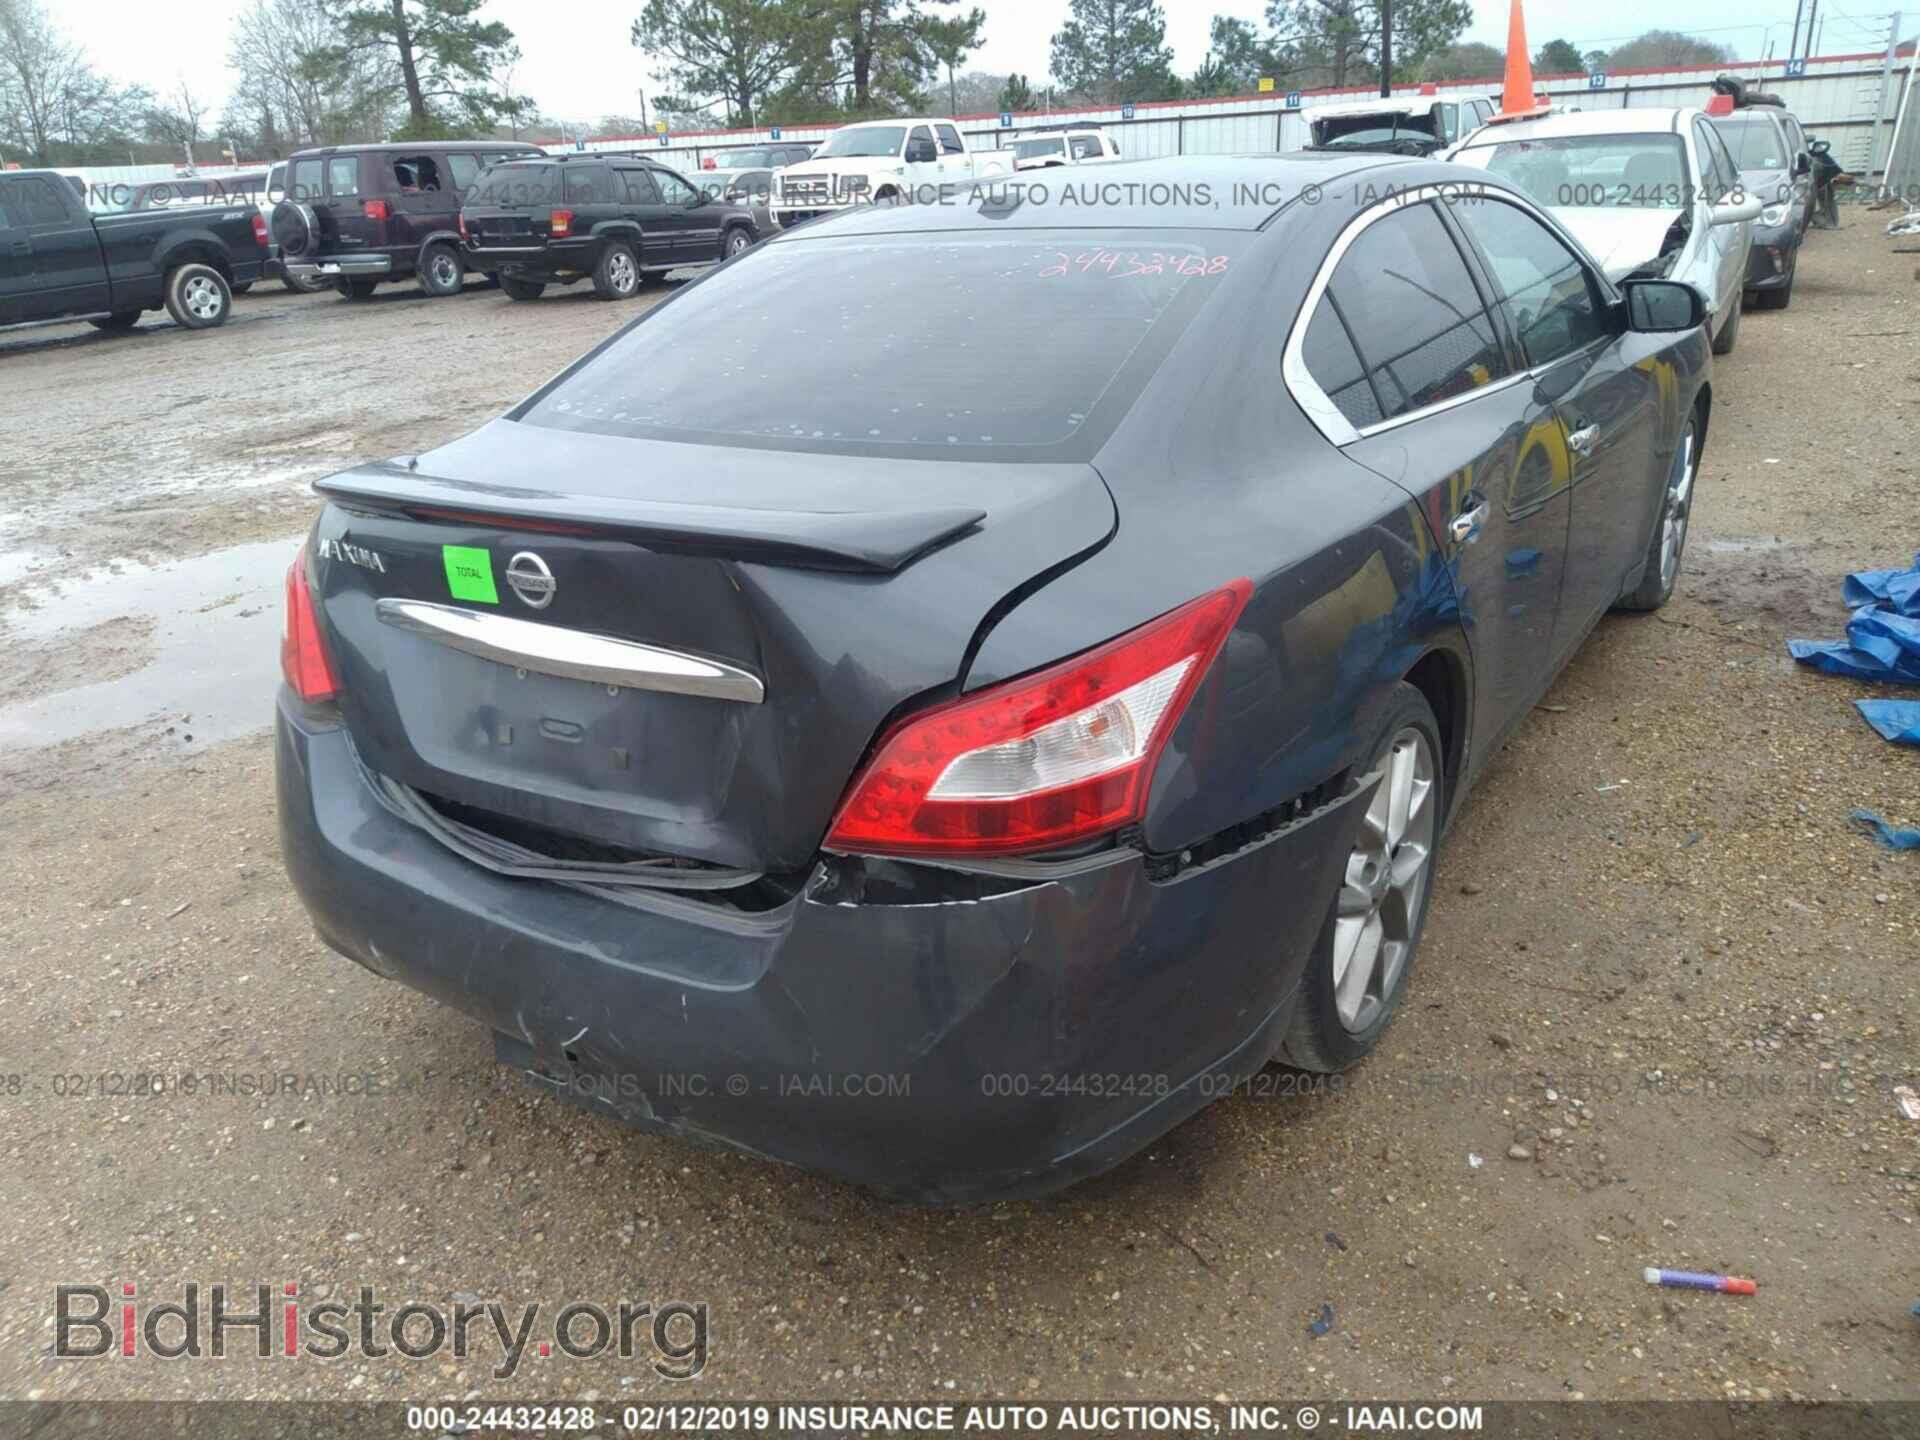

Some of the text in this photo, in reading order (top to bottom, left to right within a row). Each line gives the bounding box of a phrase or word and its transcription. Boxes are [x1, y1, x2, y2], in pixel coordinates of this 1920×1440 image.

[1788, 60, 1803, 73] 14
[1591, 74, 1605, 87] 13
[1038, 250, 1229, 279] 24432428
[318, 538, 385, 574] MAXIMA
[455, 566, 483, 580] TOTAL
